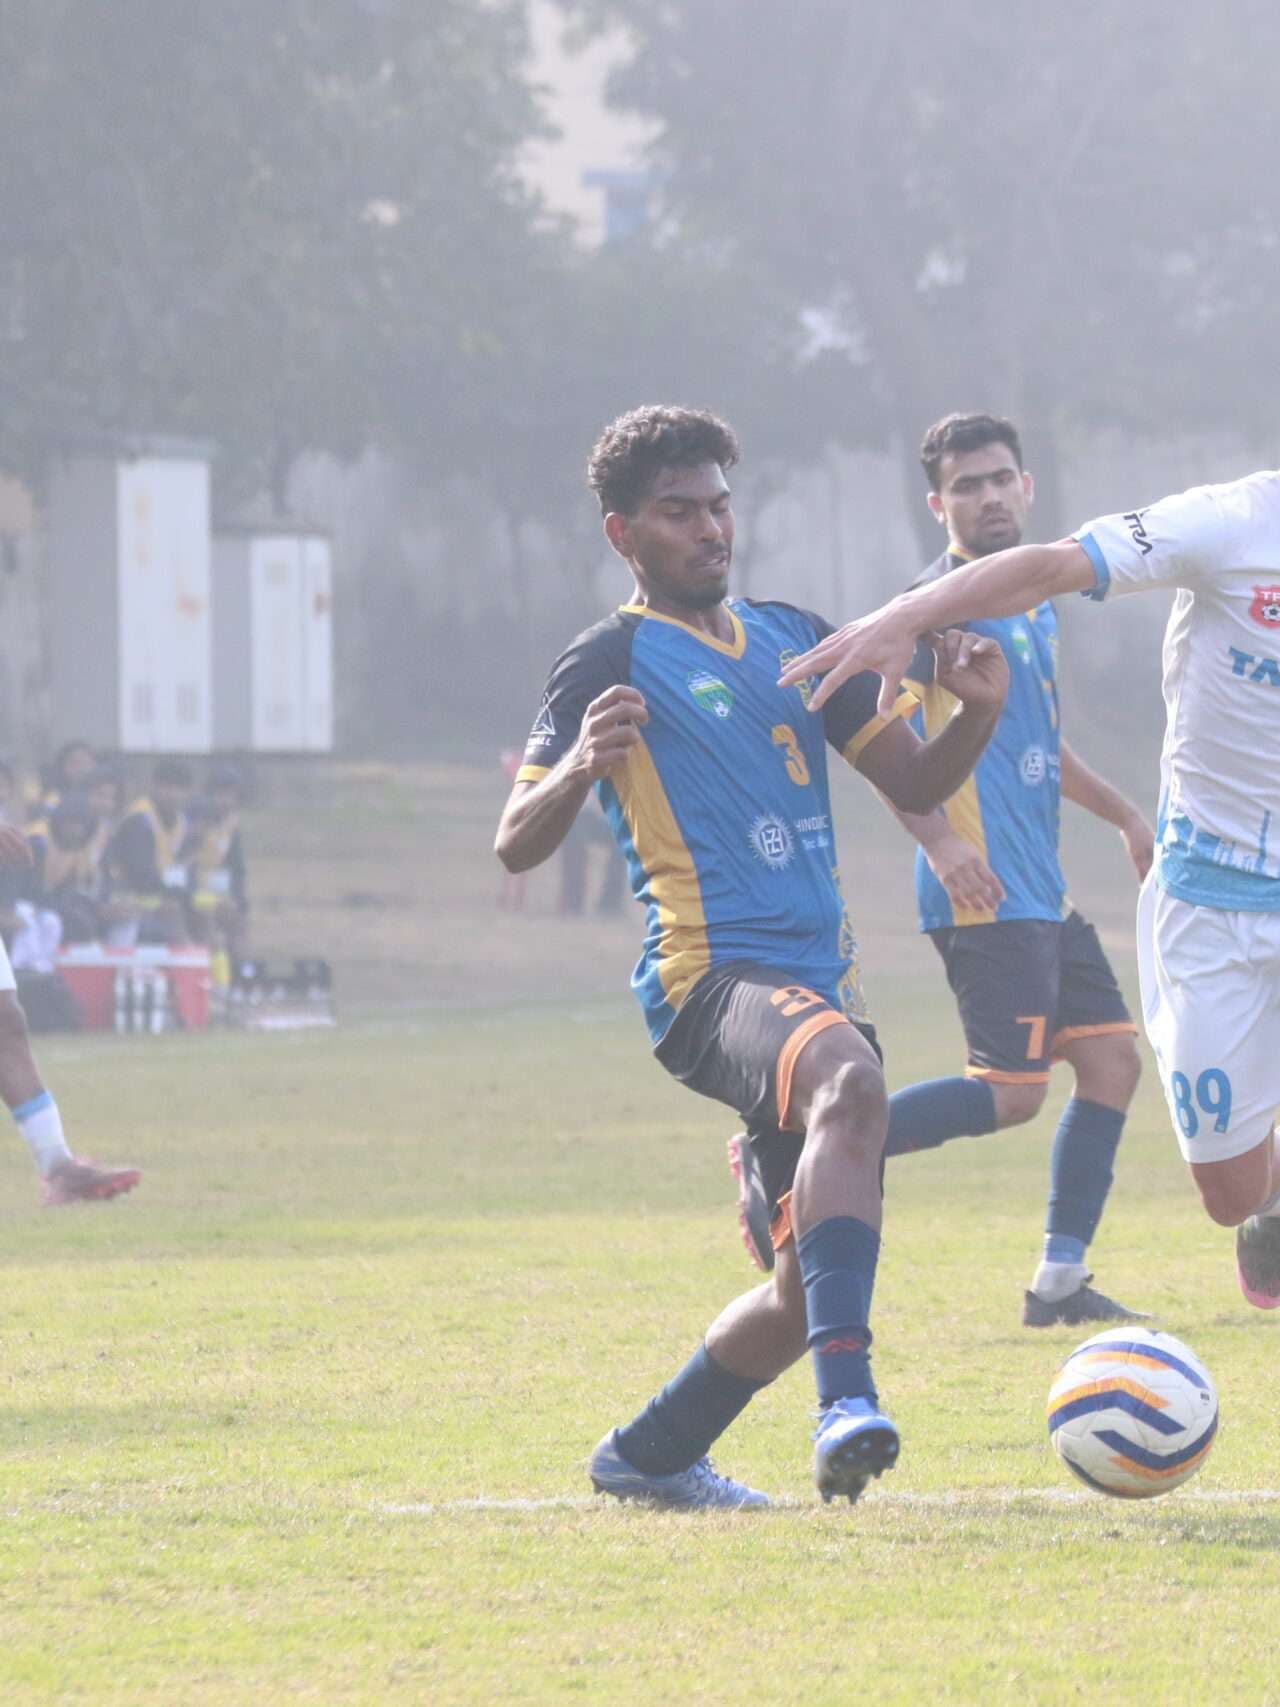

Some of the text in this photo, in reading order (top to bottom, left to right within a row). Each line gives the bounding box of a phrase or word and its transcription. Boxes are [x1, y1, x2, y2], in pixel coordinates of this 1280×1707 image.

[771, 723, 811, 786] 3
[1016, 1016, 1047, 1060] 7
[1171, 1068, 1233, 1139] 89
